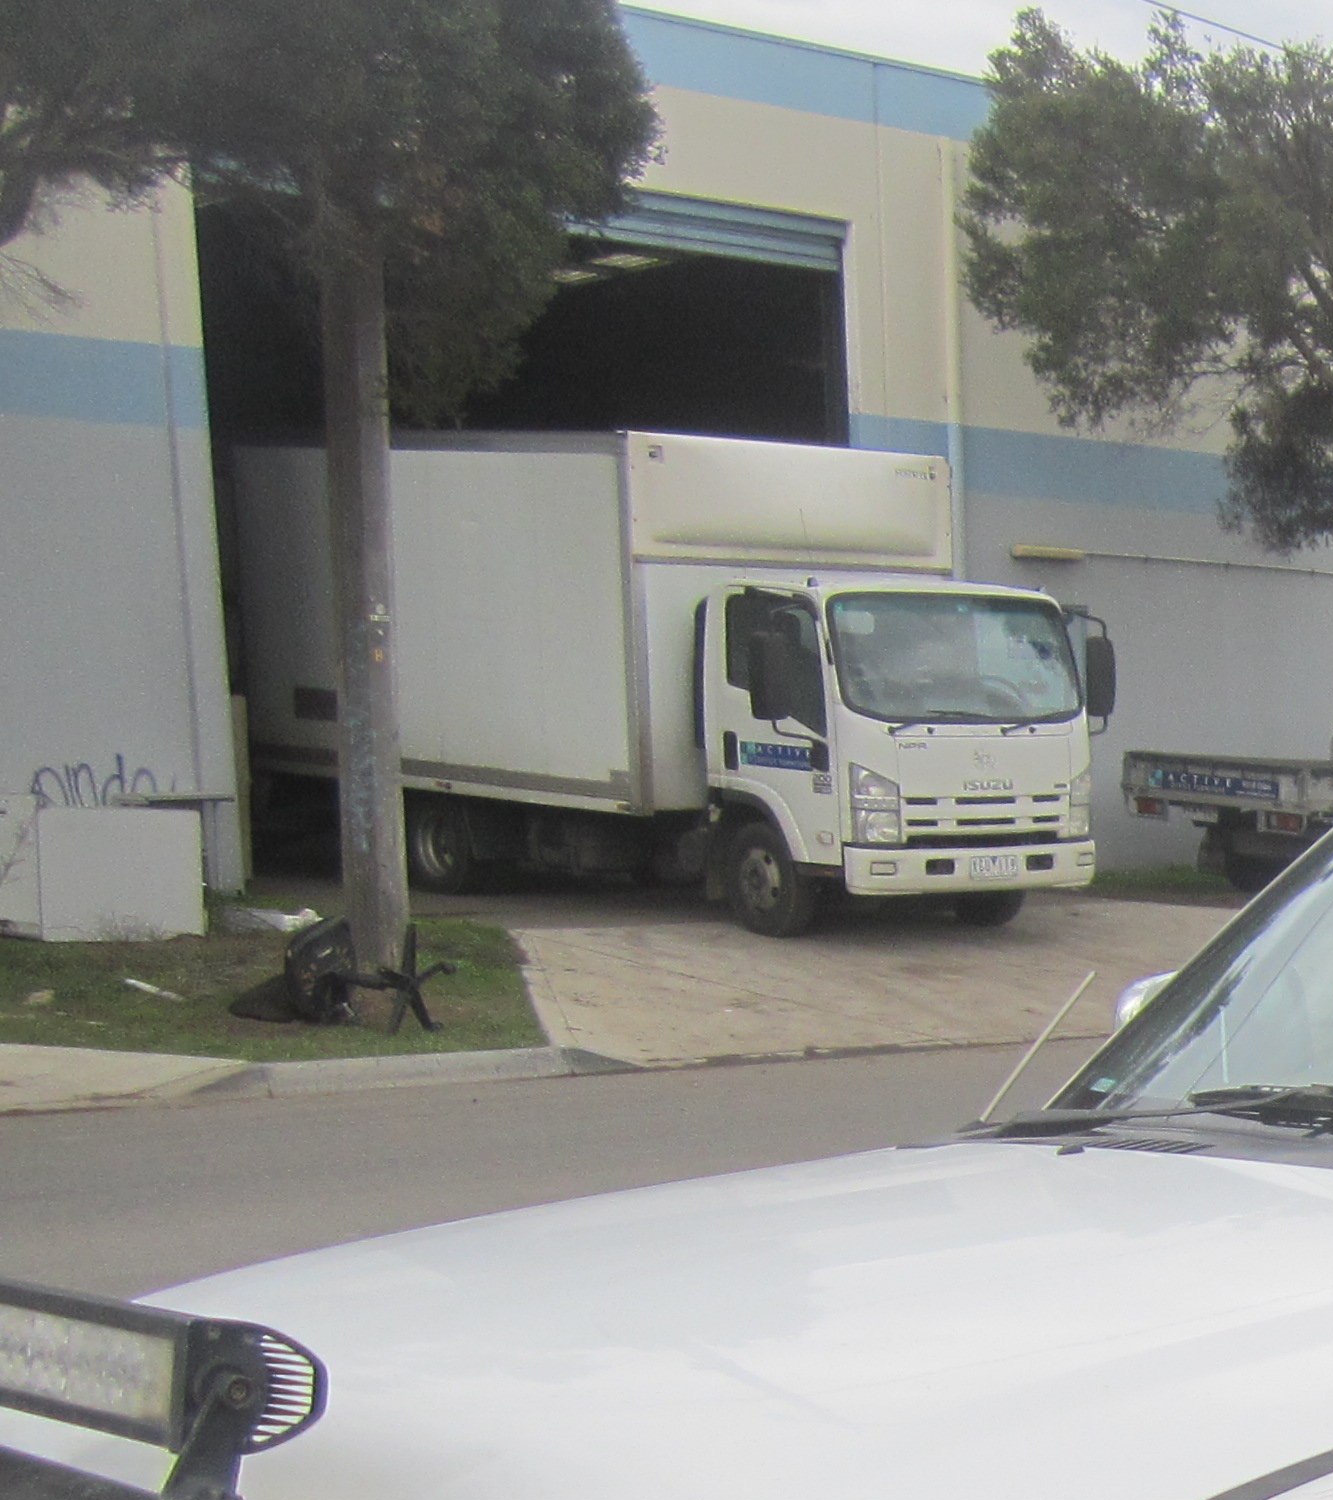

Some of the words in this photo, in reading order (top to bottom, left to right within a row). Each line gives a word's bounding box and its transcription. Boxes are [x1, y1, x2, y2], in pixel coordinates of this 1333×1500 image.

[899, 742, 928, 750] NPR
[964, 780, 1014, 791] ISUZU
[1168, 774, 1232, 788] ACTIVE
